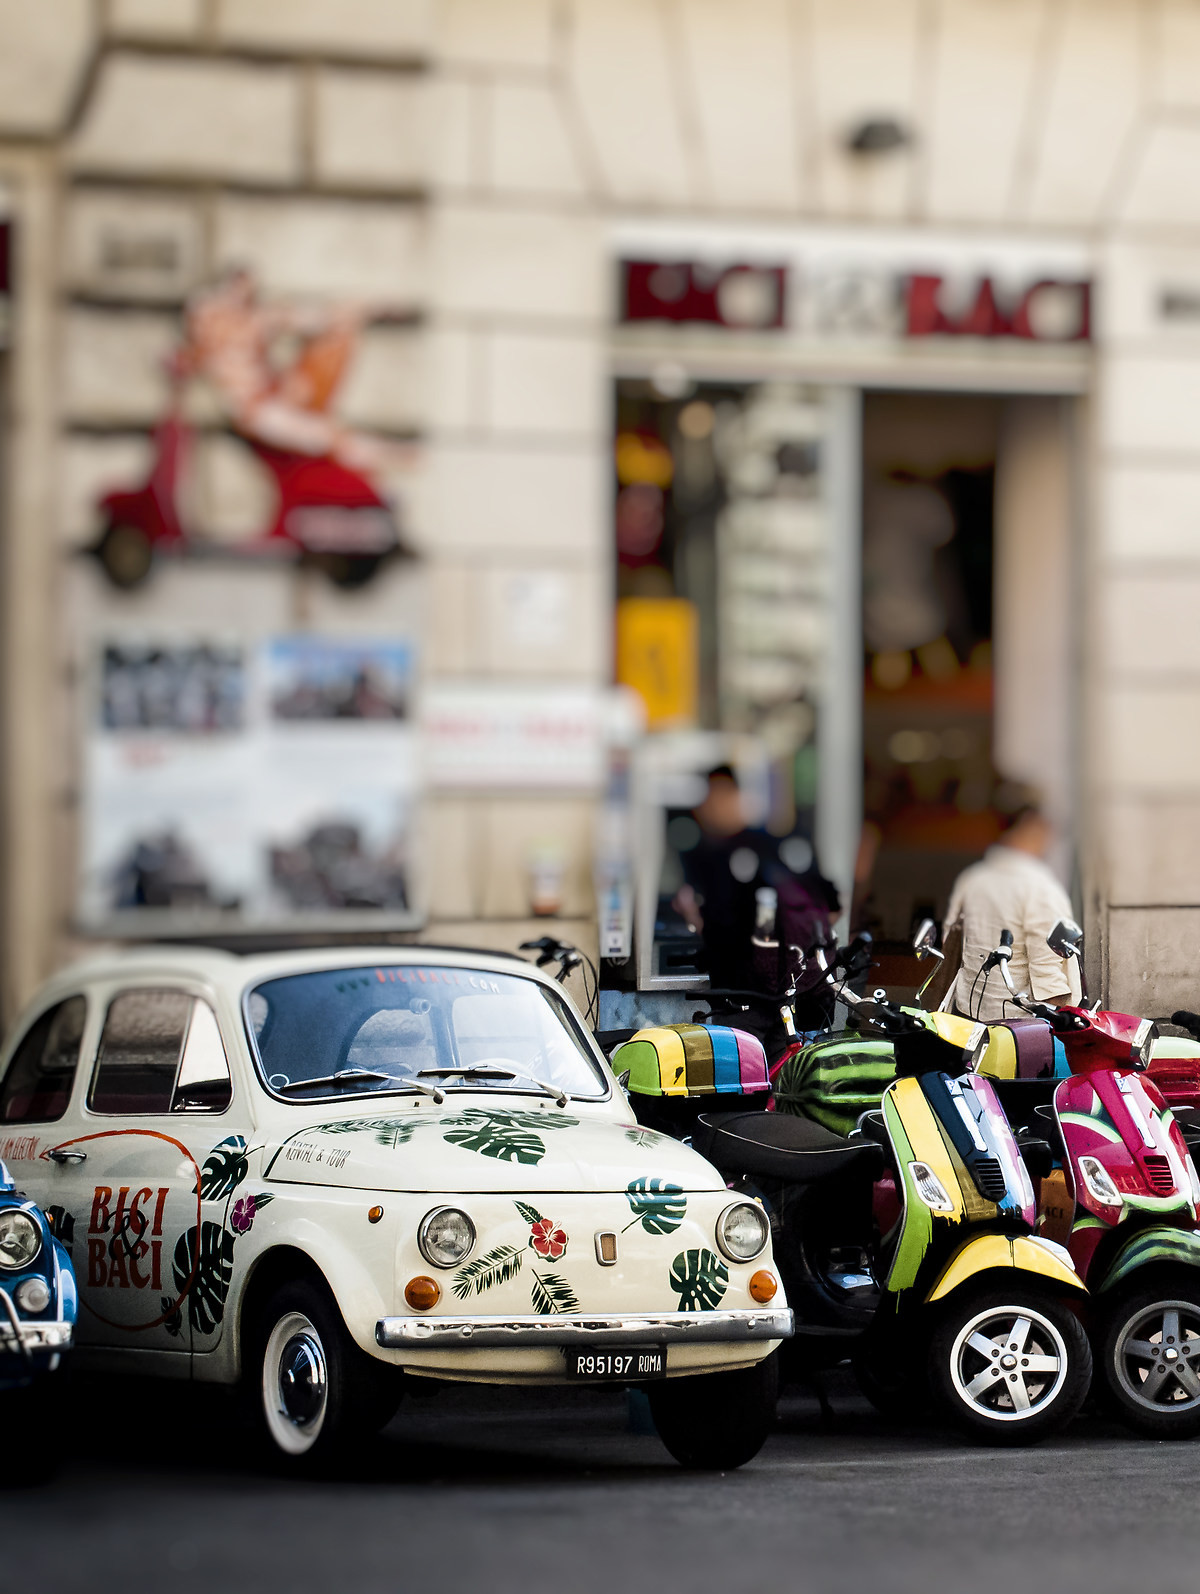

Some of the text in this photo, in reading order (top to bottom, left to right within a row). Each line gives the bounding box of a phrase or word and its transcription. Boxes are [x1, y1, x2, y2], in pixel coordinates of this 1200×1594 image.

[286, 1140, 318, 1164] RENTAL
[325, 1148, 352, 1169] TOUR
[87, 1186, 170, 1236] BICI
[103, 1208, 149, 1262] &
[87, 1238, 163, 1291] BACI
[576, 1355, 662, 1374] R95197 ROMA
